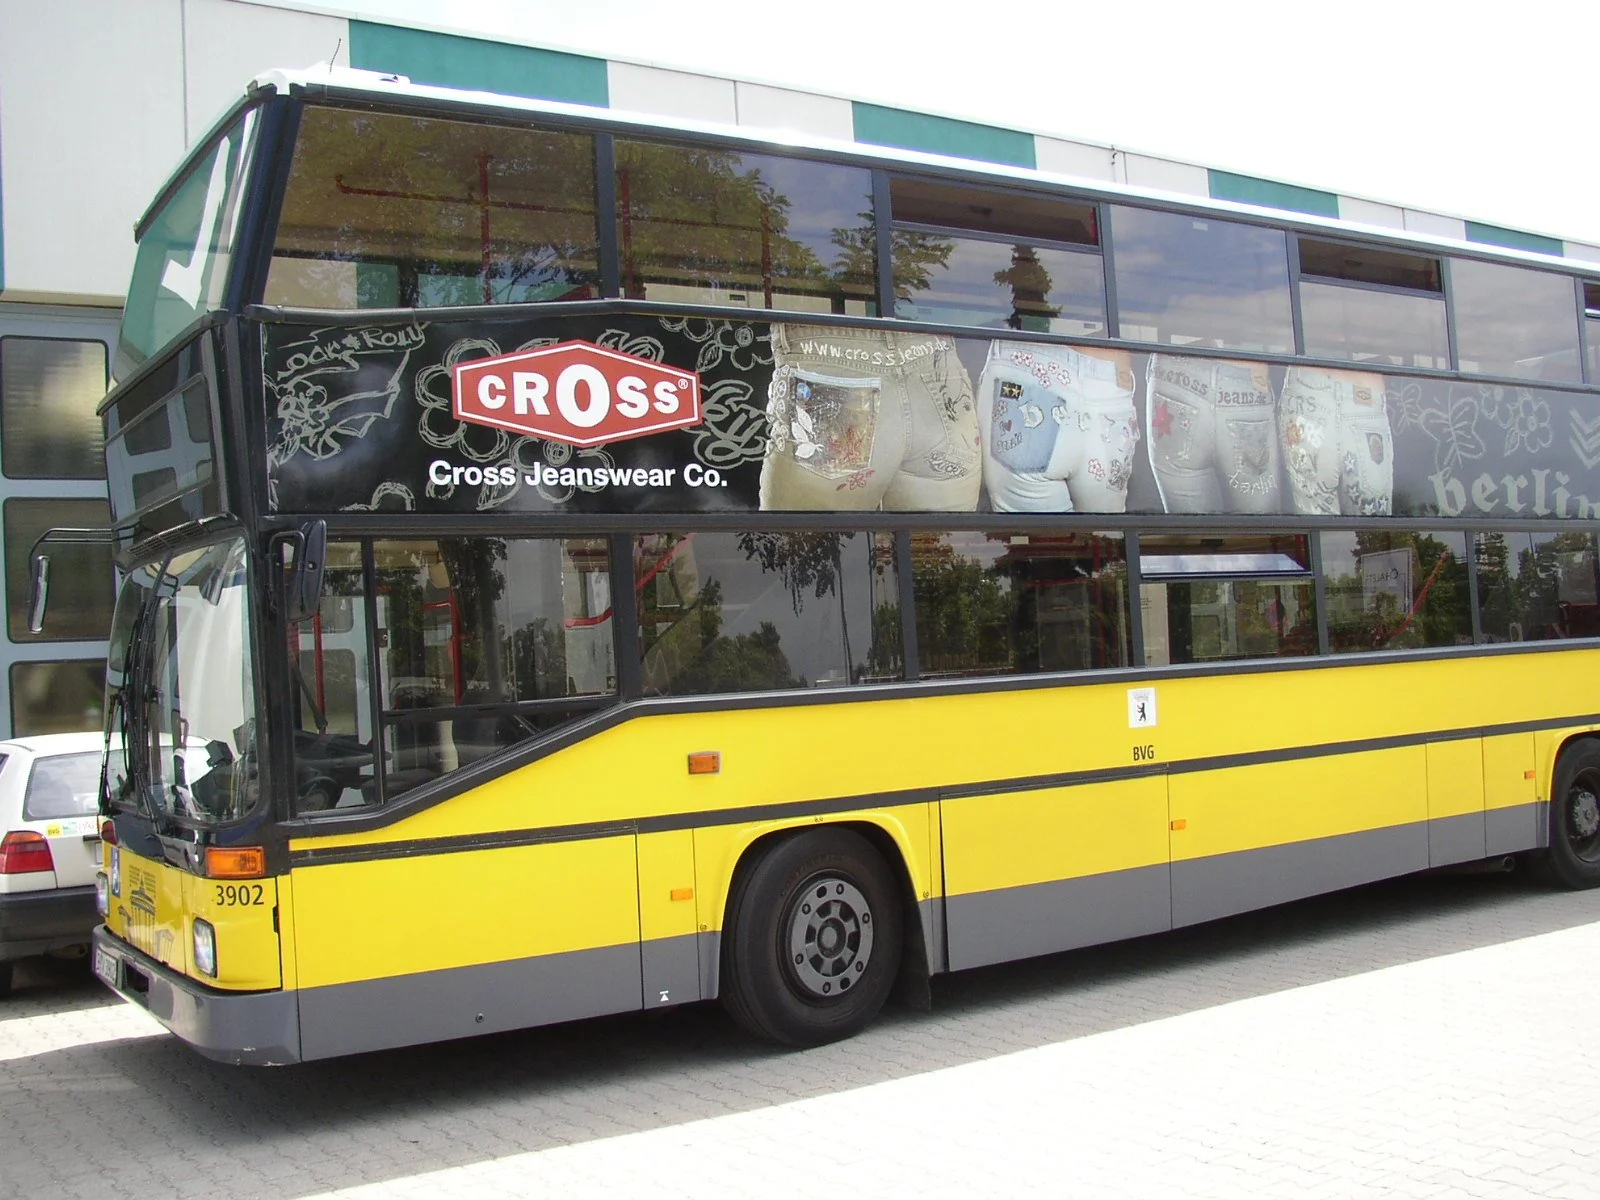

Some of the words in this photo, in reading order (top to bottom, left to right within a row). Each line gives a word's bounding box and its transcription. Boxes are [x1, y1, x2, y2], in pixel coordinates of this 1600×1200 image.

[428, 459, 516, 487] Cross
[524, 461, 676, 488] Jeanswear
[683, 463, 728, 487] Co.
[1133, 745, 1155, 761] BVG
[216, 884, 265, 906] 3902
